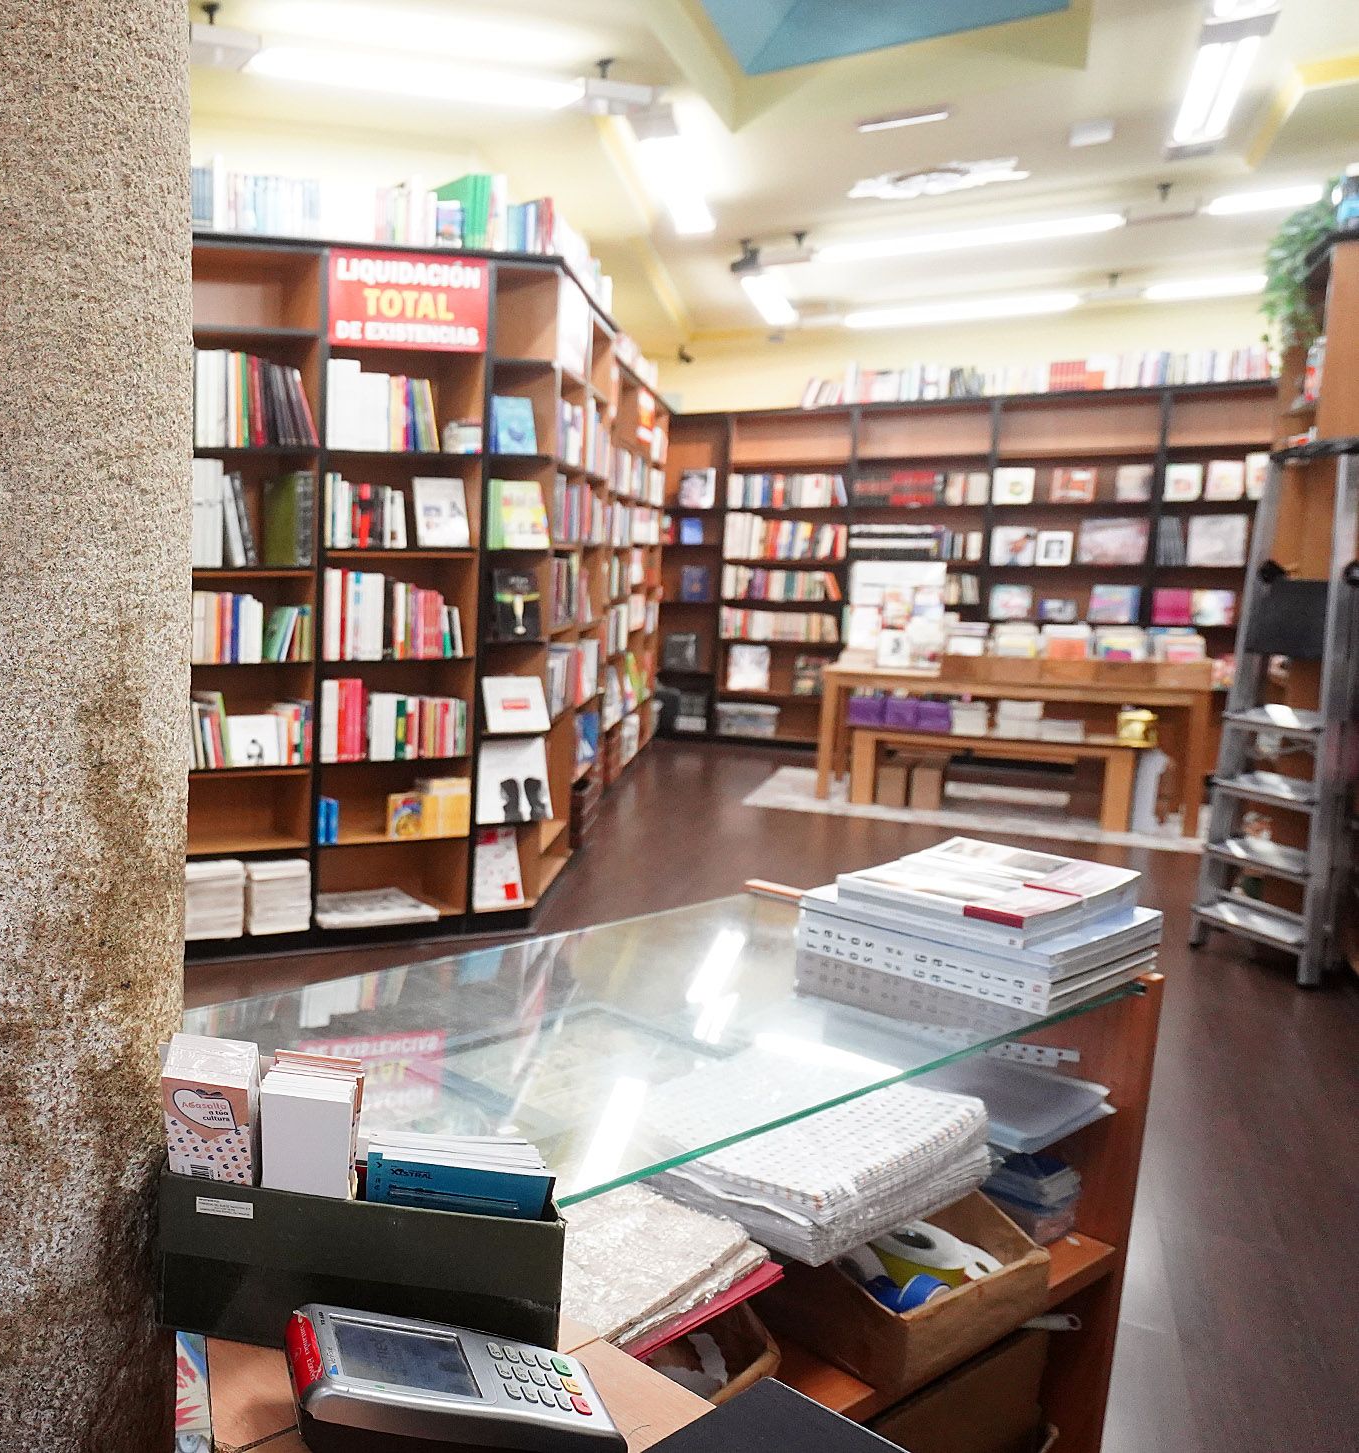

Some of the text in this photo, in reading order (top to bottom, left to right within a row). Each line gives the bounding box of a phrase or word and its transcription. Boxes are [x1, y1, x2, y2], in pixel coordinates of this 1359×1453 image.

[336, 257, 481, 289] LIQUIDACIÓN
[363, 288, 455, 321] TOTAL
[335, 319, 480, 346] DE EXISTENCIAS
